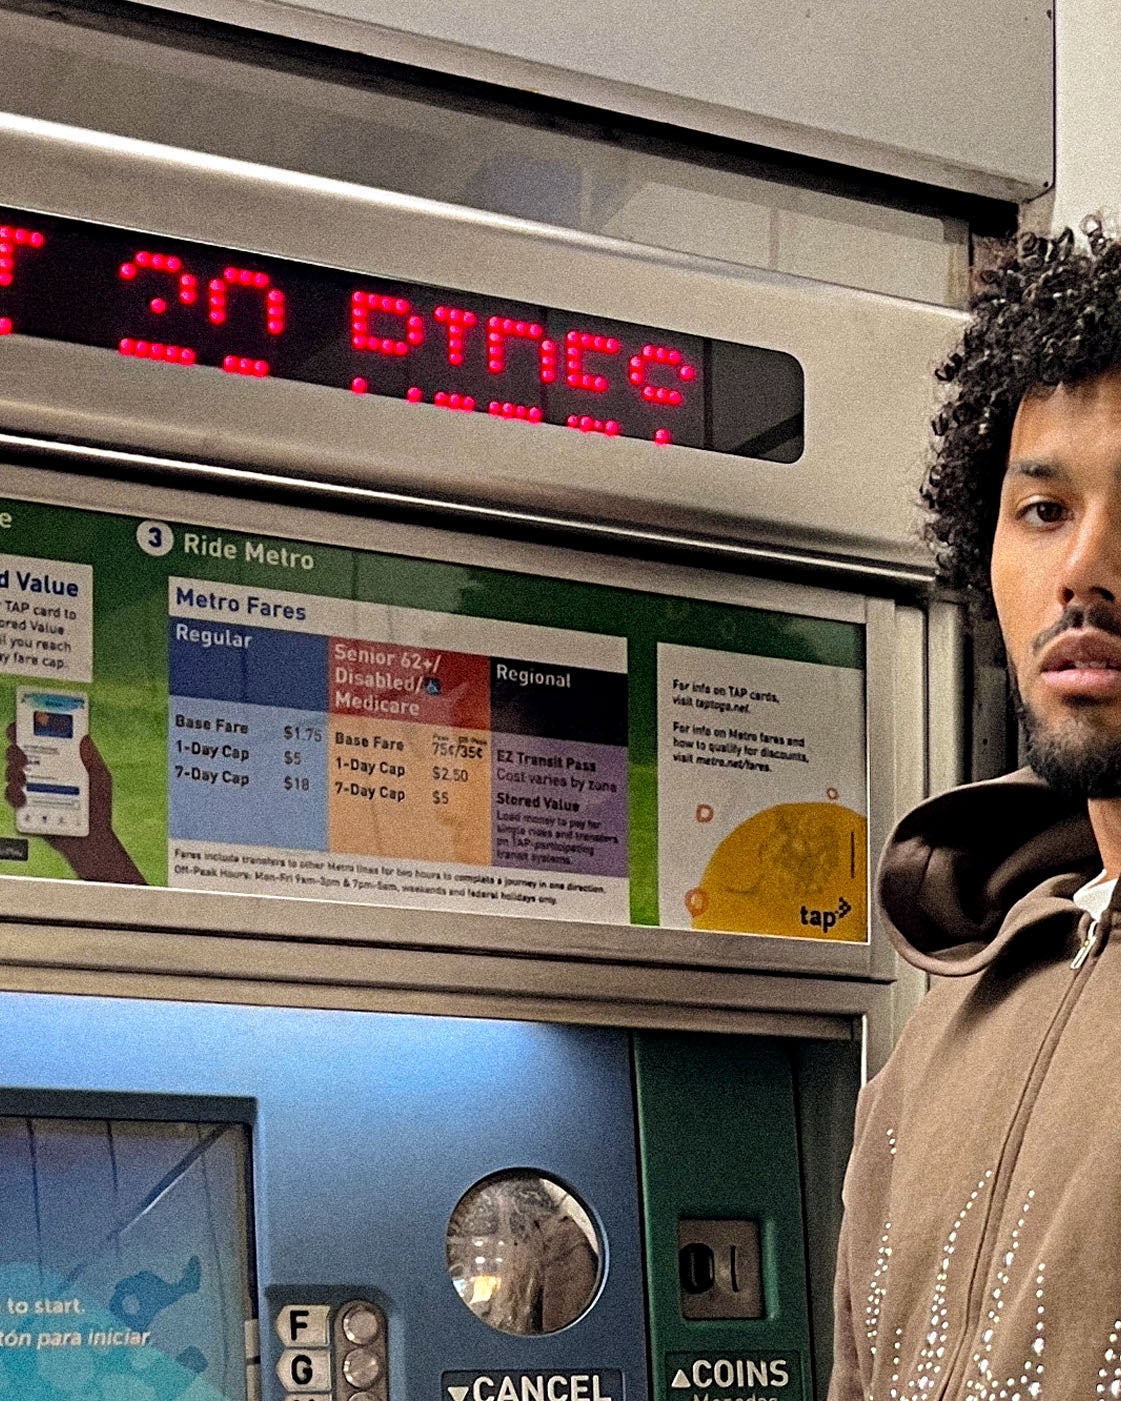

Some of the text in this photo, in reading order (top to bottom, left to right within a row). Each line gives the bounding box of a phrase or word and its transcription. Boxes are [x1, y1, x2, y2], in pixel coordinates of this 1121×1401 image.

[148, 527, 315, 570] 3 Ride Metro
[16, 571, 79, 597] Value
[5, 600, 77, 620] TAP card to
[176, 586, 307, 621] Metro Fares
[30, 620, 65, 635] Value
[176, 623, 253, 648] Regular
[10, 637, 33, 649] you
[36, 640, 72, 652] reach
[335, 644, 396, 667] Senior
[13, 652, 38, 665] fare
[335, 667, 424, 693] Disabled/
[496, 664, 571, 688] Regional
[673, 679, 690, 690] For
[692, 683, 711, 694] info
[713, 687, 726, 696] on
[728, 685, 748, 698] TAP
[335, 691, 421, 716] Medicare
[673, 695, 692, 706] visit
[175, 714, 323, 743] Base Fare $1.75
[673, 721, 805, 748] For info on Metro fares and
[176, 739, 302, 766] 1-Day Cap $5
[335, 732, 369, 748] Base
[373, 736, 405, 752] Fare
[673, 737, 693, 748] how
[696, 741, 706, 751] to
[708, 742, 742, 757] qualify
[744, 745, 757, 756] for
[336, 757, 469, 782] 1-Day Cap $2.50
[497, 750, 597, 772] EZ Transit Pass
[673, 753, 693, 764] visit
[175, 765, 310, 791] 7-Day Cap $18
[496, 768, 617, 793] Cost varies by zone
[335, 782, 449, 805] 7-Day Cap $5
[496, 792, 580, 812] Stored Value
[497, 810, 521, 821] Load
[174, 848, 201, 860] Fares
[204, 852, 239, 863] include
[242, 855, 285, 867] transfers
[289, 859, 298, 868] to
[300, 859, 324, 870] other
[381, 866, 395, 876] for
[415, 870, 441, 880] hours
[454, 873, 495, 885] complete
[504, 877, 537, 889] journey
[539, 880, 547, 888] in
[550, 882, 565, 890] one
[174, 864, 217, 877] Off-Peak
[449, 888, 465, 897] and
[467, 888, 498, 900] federal
[500, 891, 536, 904] holidays
[800, 905, 836, 933] tap
[7, 1297, 86, 1314] to start.
[289, 1310, 309, 1340] F
[36, 1331, 82, 1350] para
[291, 1354, 313, 1385] G
[692, 1358, 790, 1389] COINS
